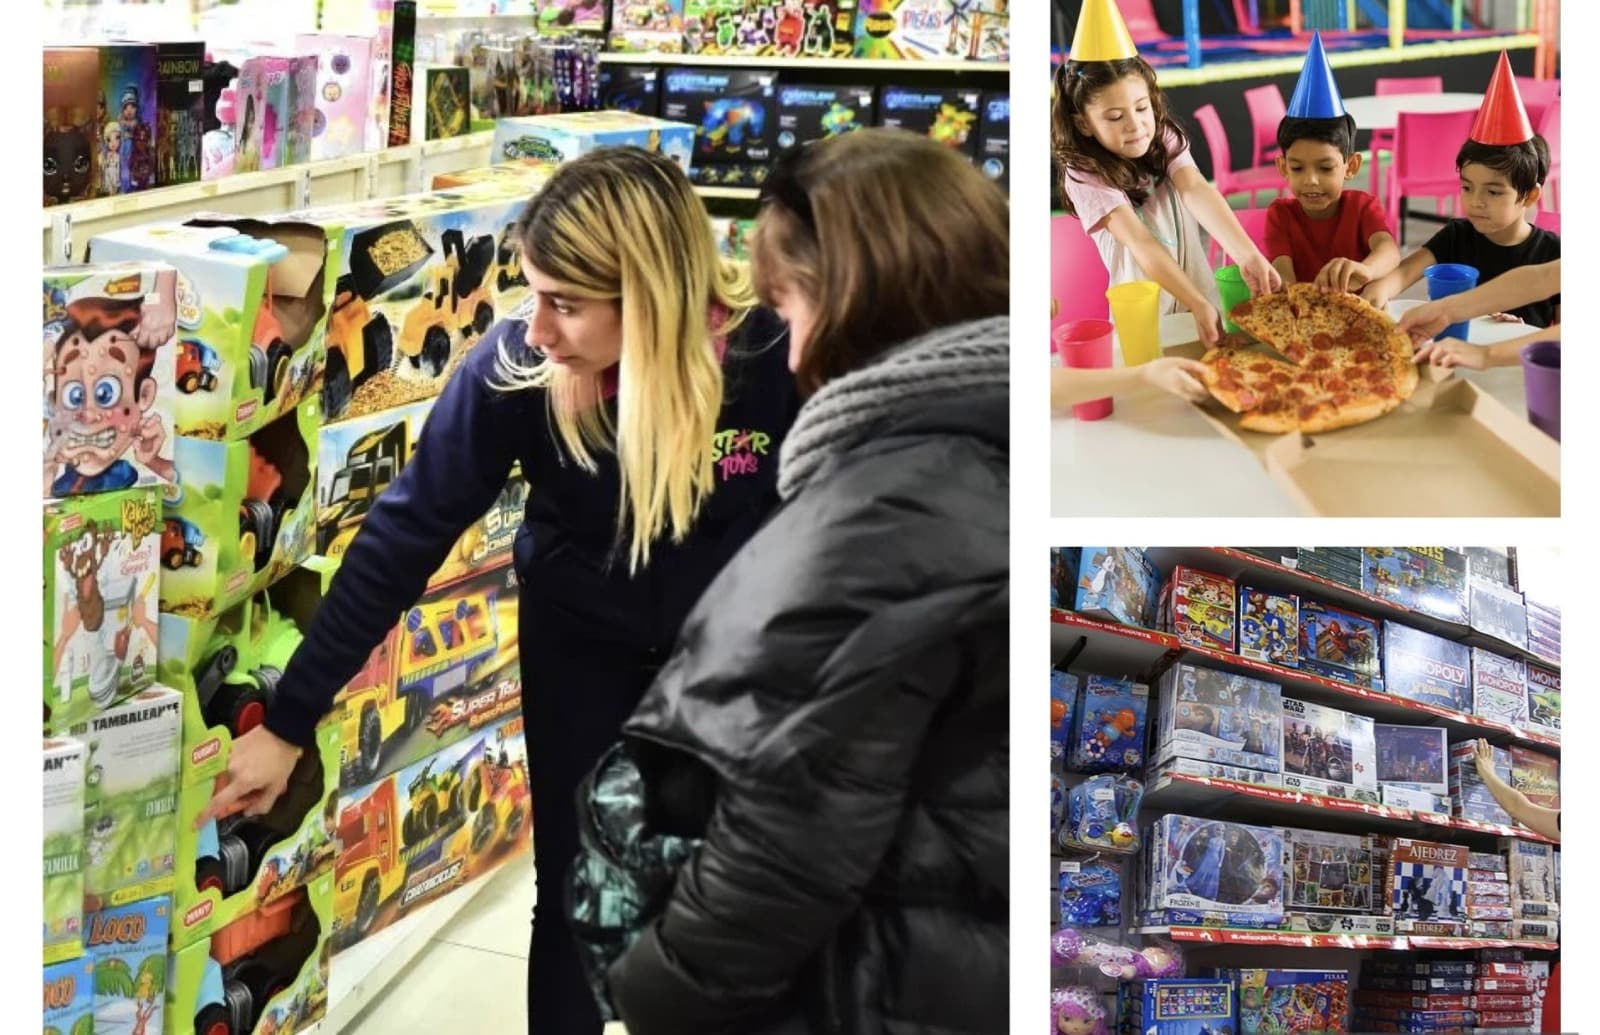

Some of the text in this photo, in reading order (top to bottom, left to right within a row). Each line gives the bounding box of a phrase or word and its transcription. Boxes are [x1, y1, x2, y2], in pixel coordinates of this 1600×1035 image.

[903, 9, 942, 29] PIEZAS
[718, 452, 758, 481] TOYS
[1479, 671, 1523, 695] MONOPOLY
[452, 691, 497, 721] SUPER
[1409, 845, 1457, 862] AJEDREZ
